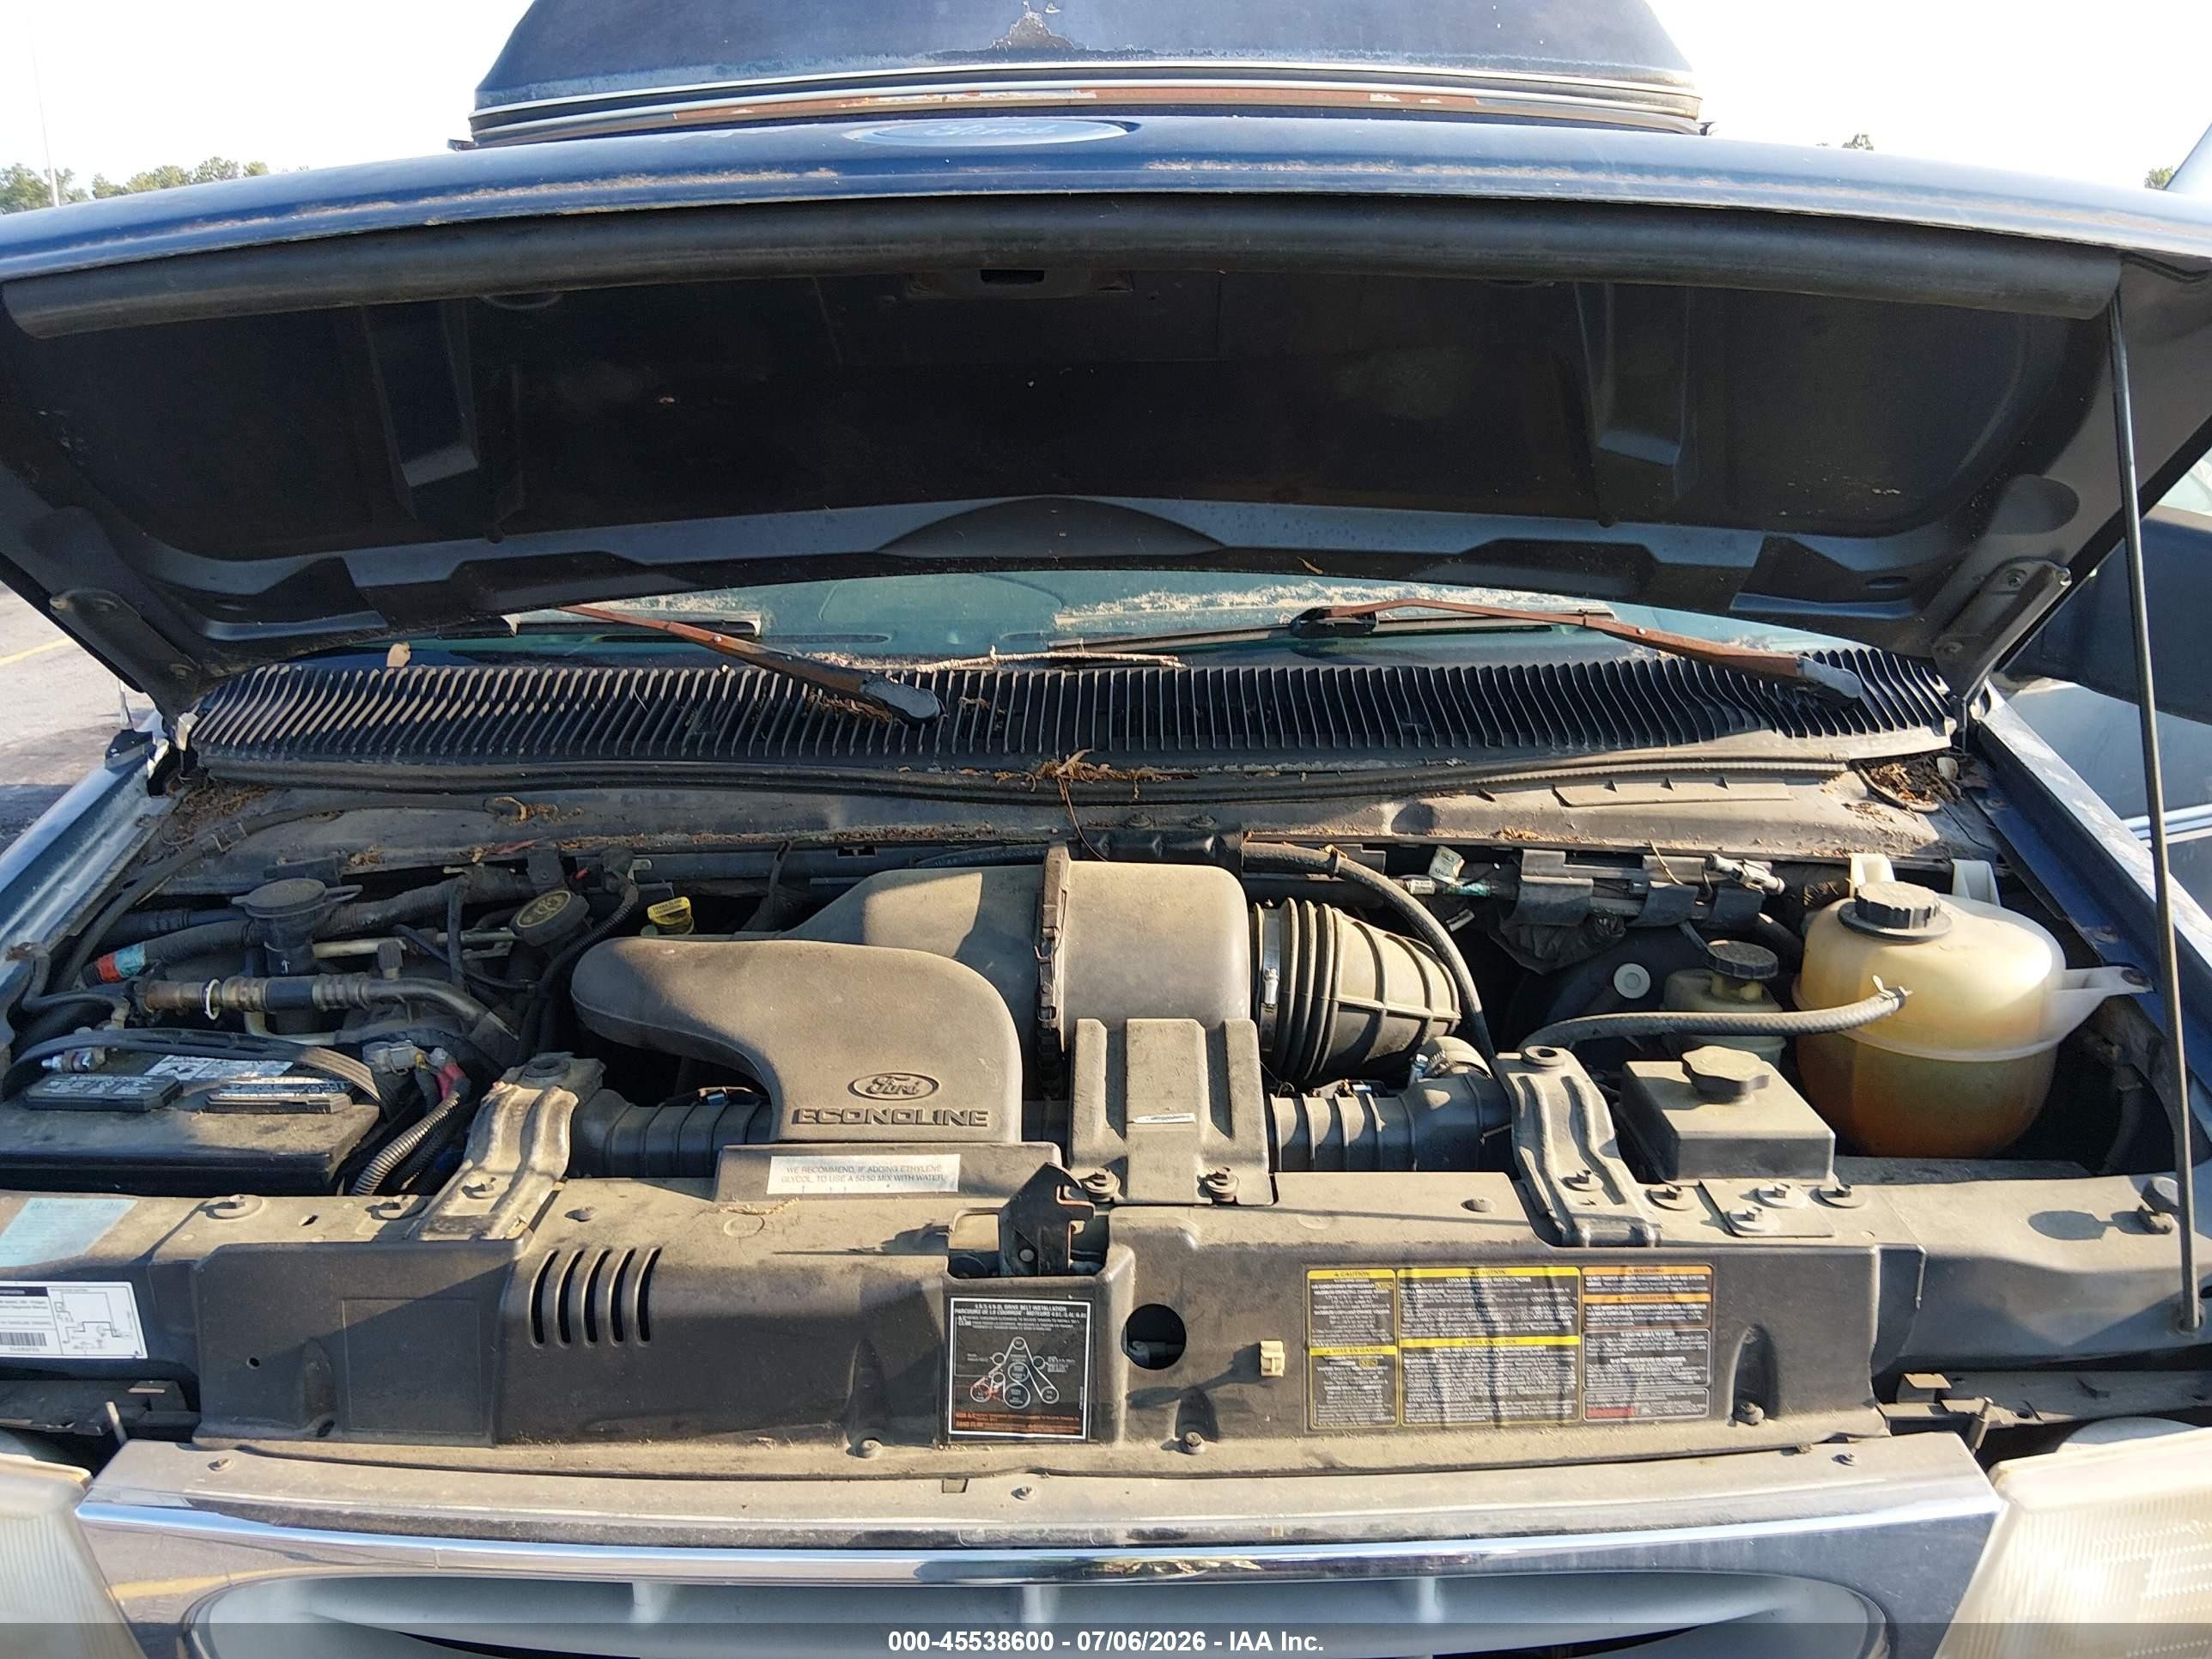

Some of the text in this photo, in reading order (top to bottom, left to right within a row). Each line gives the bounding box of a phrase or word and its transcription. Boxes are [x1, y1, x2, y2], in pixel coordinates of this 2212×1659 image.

[865, 1075, 921, 1096] Ford
[792, 1108, 989, 1127] ECONOLINE
[900, 1164, 941, 1173] ETHYLENE
